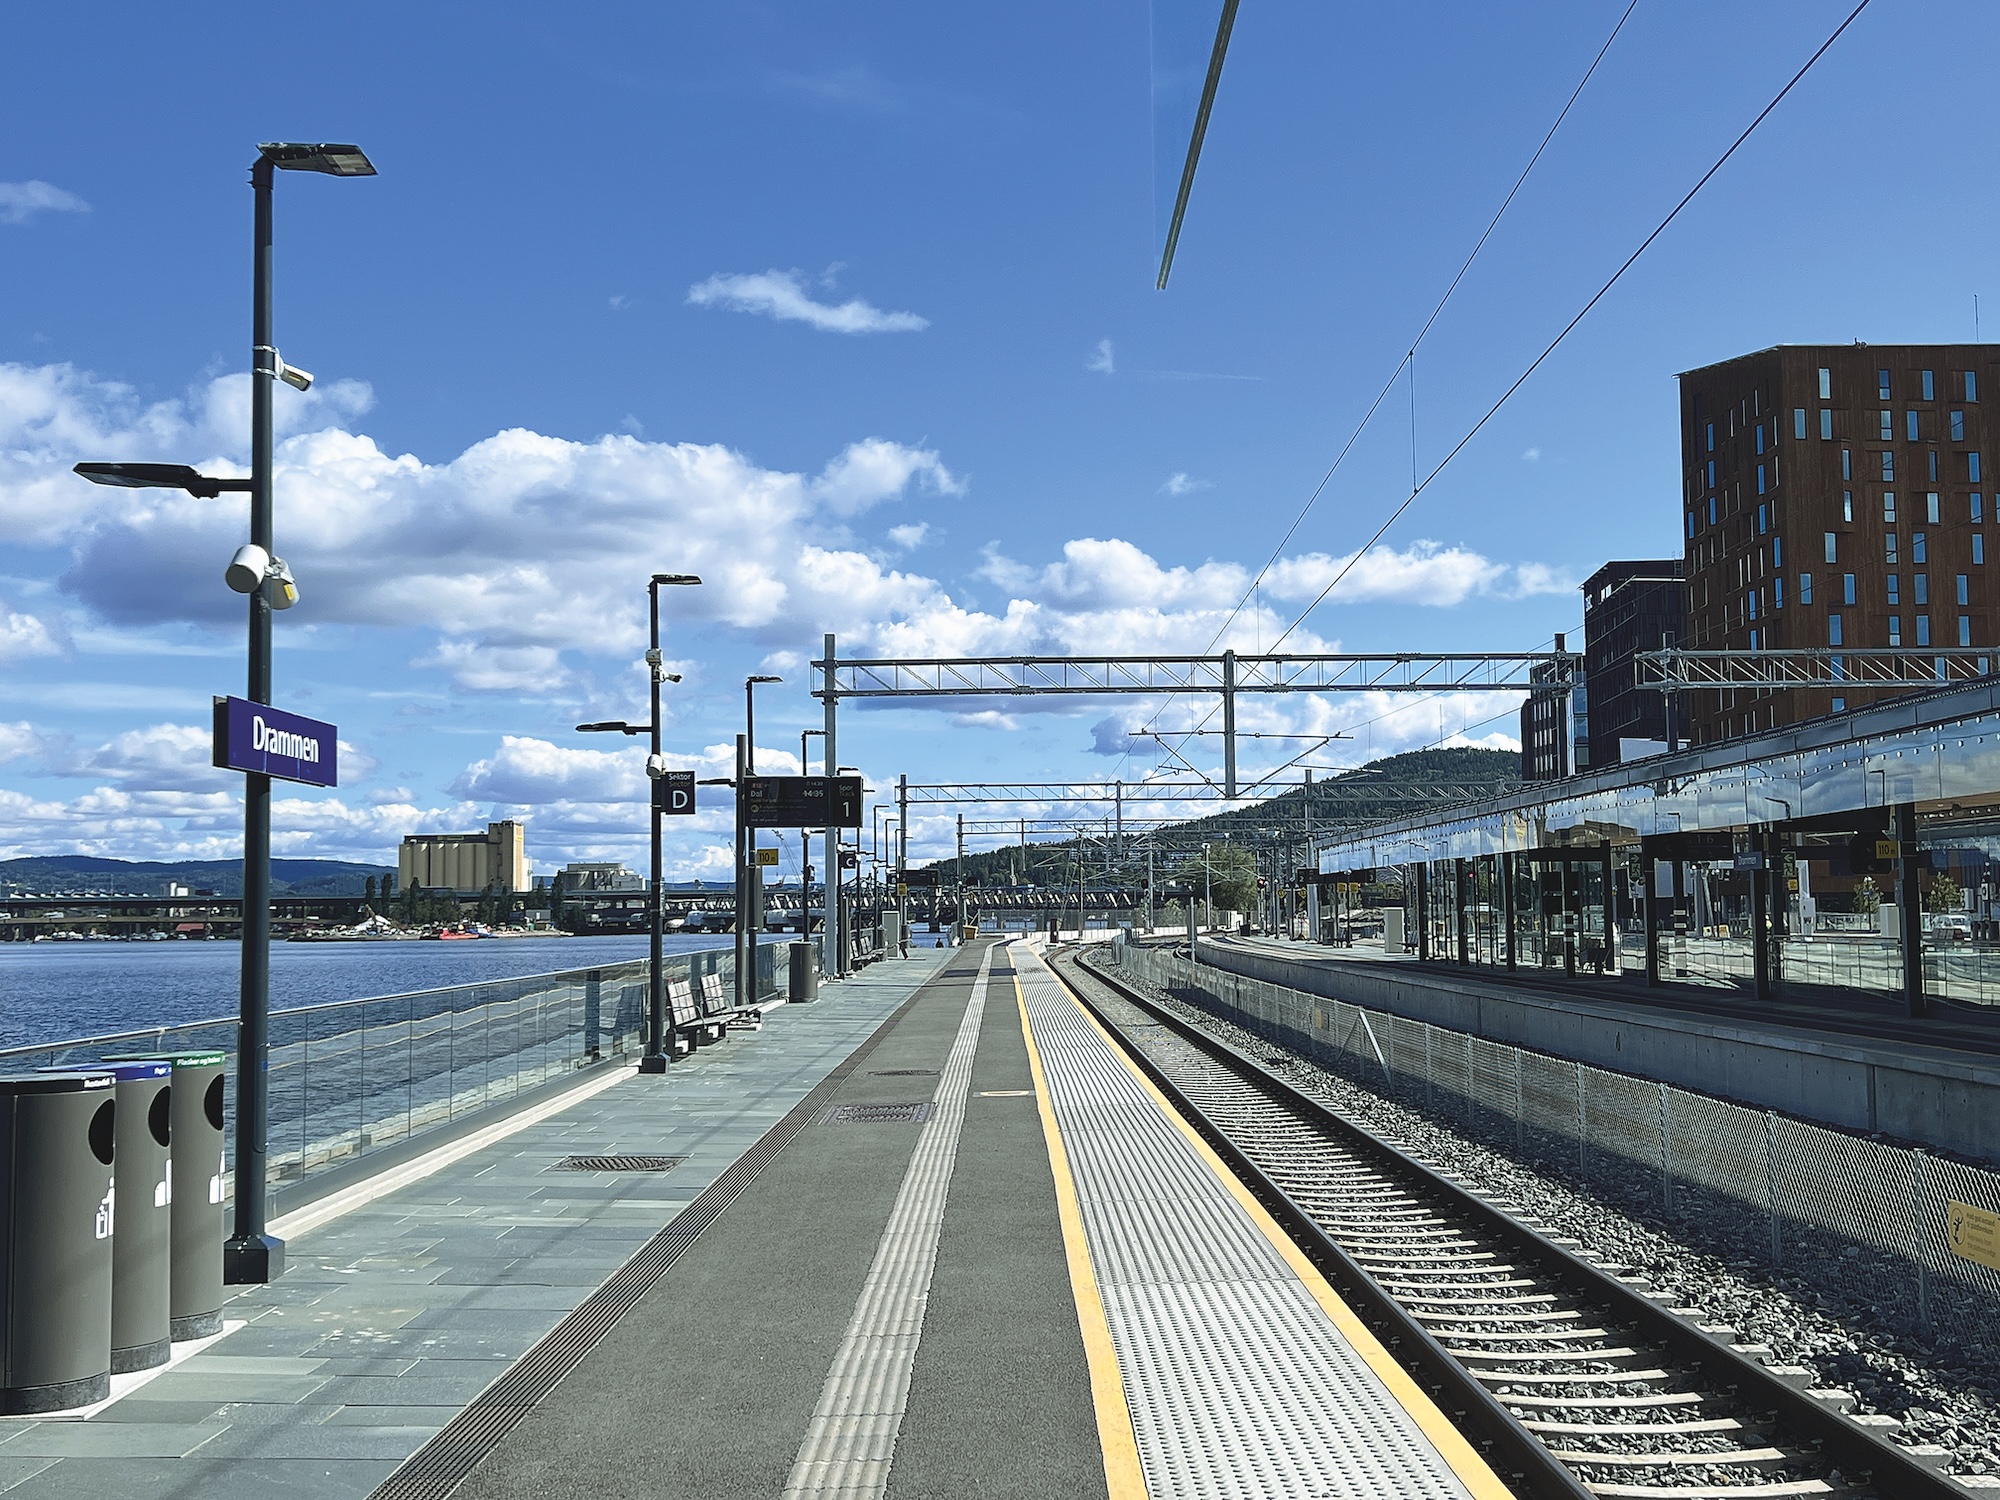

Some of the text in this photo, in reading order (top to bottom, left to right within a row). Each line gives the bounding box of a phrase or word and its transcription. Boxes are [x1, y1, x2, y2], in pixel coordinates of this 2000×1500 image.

[253, 715, 319, 763] Drammen
[672, 790, 688, 808] D
[750, 790, 763, 798] Dal
[842, 801, 850, 817] 1
[1878, 844, 1890, 855] 110
[759, 852, 770, 863] 110
[846, 858, 853, 867] C
